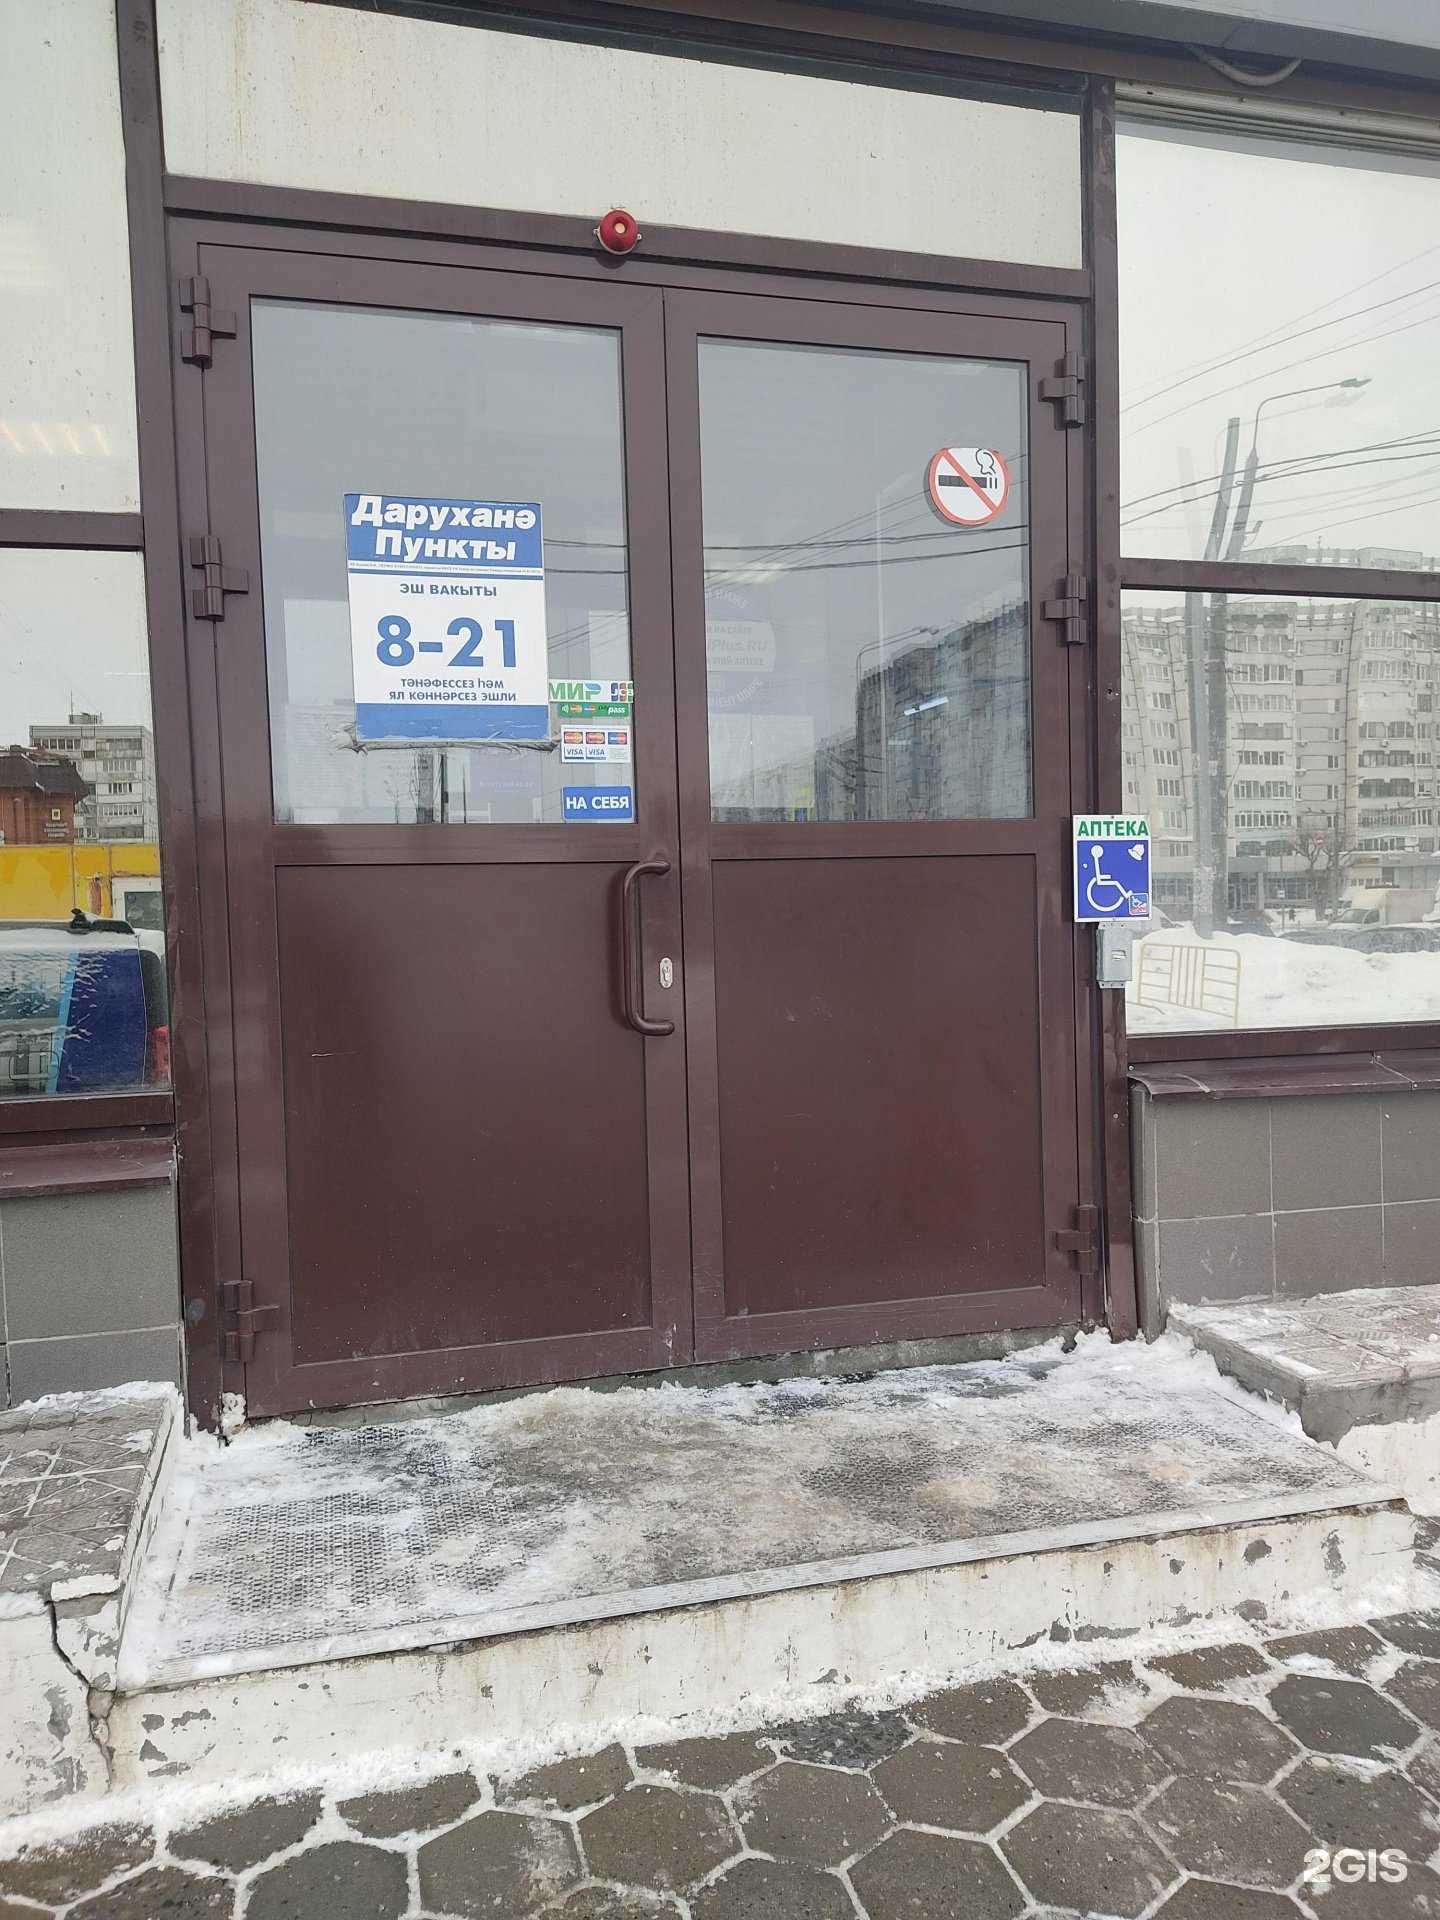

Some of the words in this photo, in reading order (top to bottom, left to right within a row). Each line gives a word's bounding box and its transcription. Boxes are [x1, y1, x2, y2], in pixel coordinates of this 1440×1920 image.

[352, 495, 536, 531] Даруханә
[375, 529, 516, 561] Пункты
[400, 583, 424, 594] ЭШ
[429, 584, 497, 597] ВАКЫТЫ
[389, 691, 405, 700] ЯЛ
[481, 693, 516, 701] ЭШЛИ
[549, 682, 602, 700] МИР
[566, 796, 588, 809] НА
[591, 796, 630, 810] СЕБЯ
[1077, 820, 1149, 837] АПТЕКА
